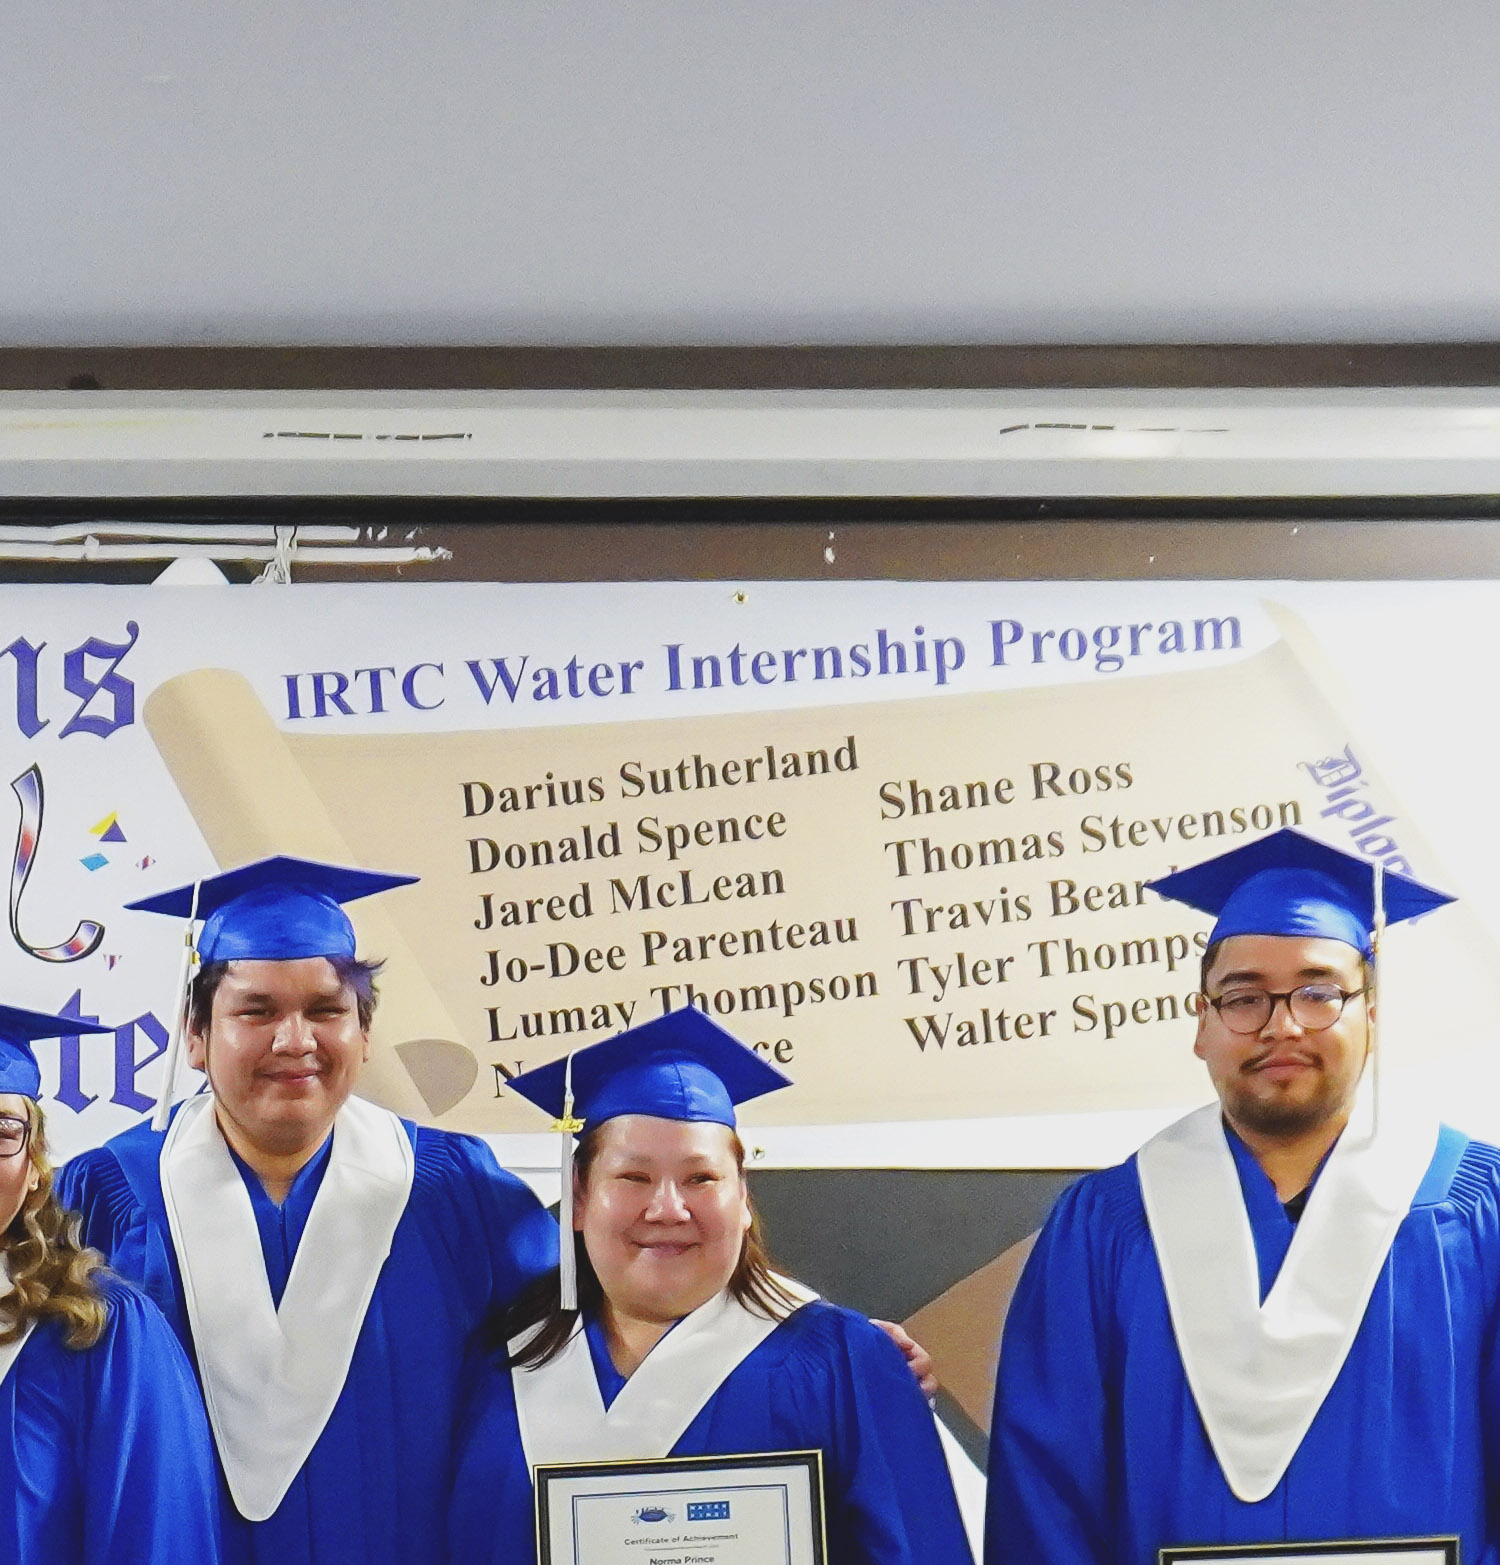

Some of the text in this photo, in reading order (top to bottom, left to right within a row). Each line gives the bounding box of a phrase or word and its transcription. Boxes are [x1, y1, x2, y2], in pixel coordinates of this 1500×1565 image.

[281, 616, 1243, 721] IRTC Water Internship Program
[459, 735, 860, 818] Darius Sutherland
[879, 762, 1134, 820] Shane Ross
[467, 811, 787, 874] Donald Spence
[884, 799, 1304, 878] Thomas Stevenson
[1296, 743, 1425, 890] Diplo
[474, 868, 787, 930] Jared McLean
[891, 866, 1178, 936] Travis Bear
[480, 917, 860, 987] Jo-Dee Parenteau
[897, 929, 1209, 1003] Tyler Thomps
[484, 970, 878, 1043] Lumay Thompson
[902, 990, 1203, 1052] Walter Spenc
[650, 1556, 714, 1565] Norma Prince
